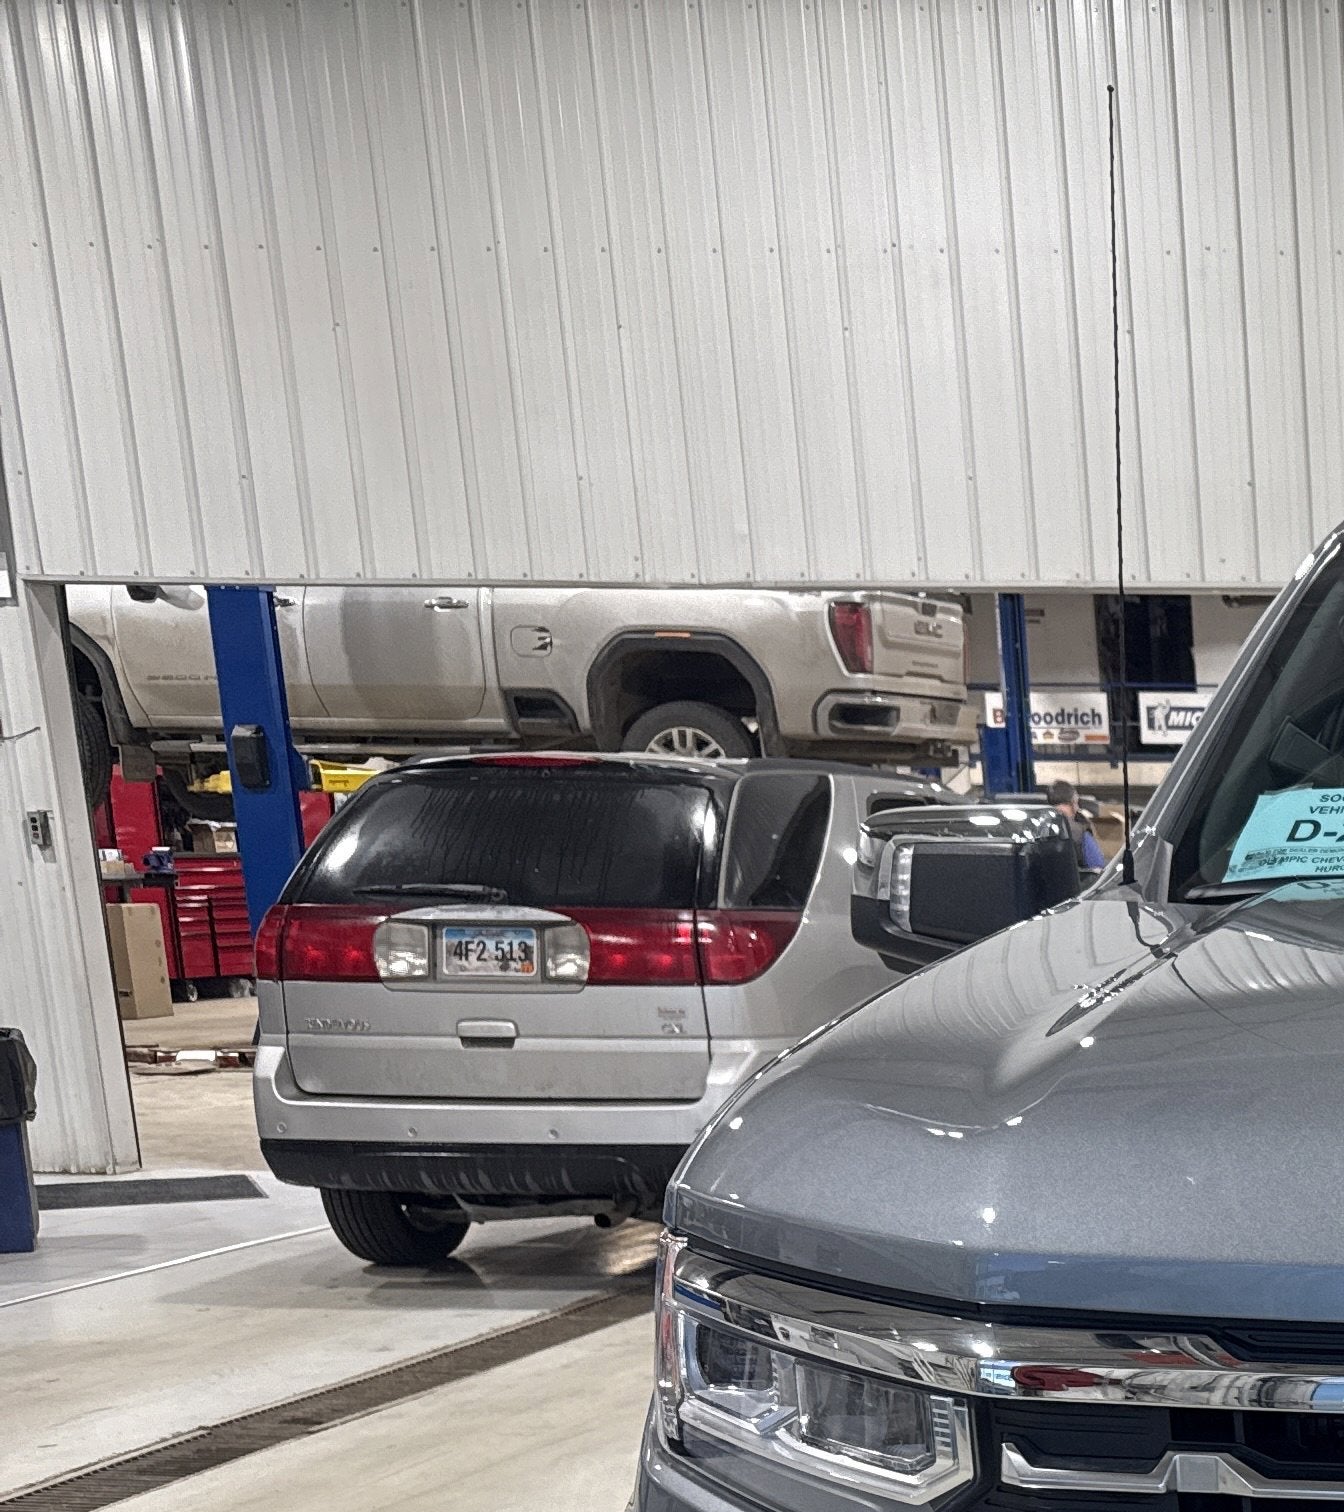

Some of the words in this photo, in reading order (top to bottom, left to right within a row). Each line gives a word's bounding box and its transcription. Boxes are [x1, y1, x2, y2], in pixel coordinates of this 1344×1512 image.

[992, 708, 1102, 726] Boodrich
[1259, 855, 1308, 866] OLYMPIC
[453, 940, 487, 961] 4F2
